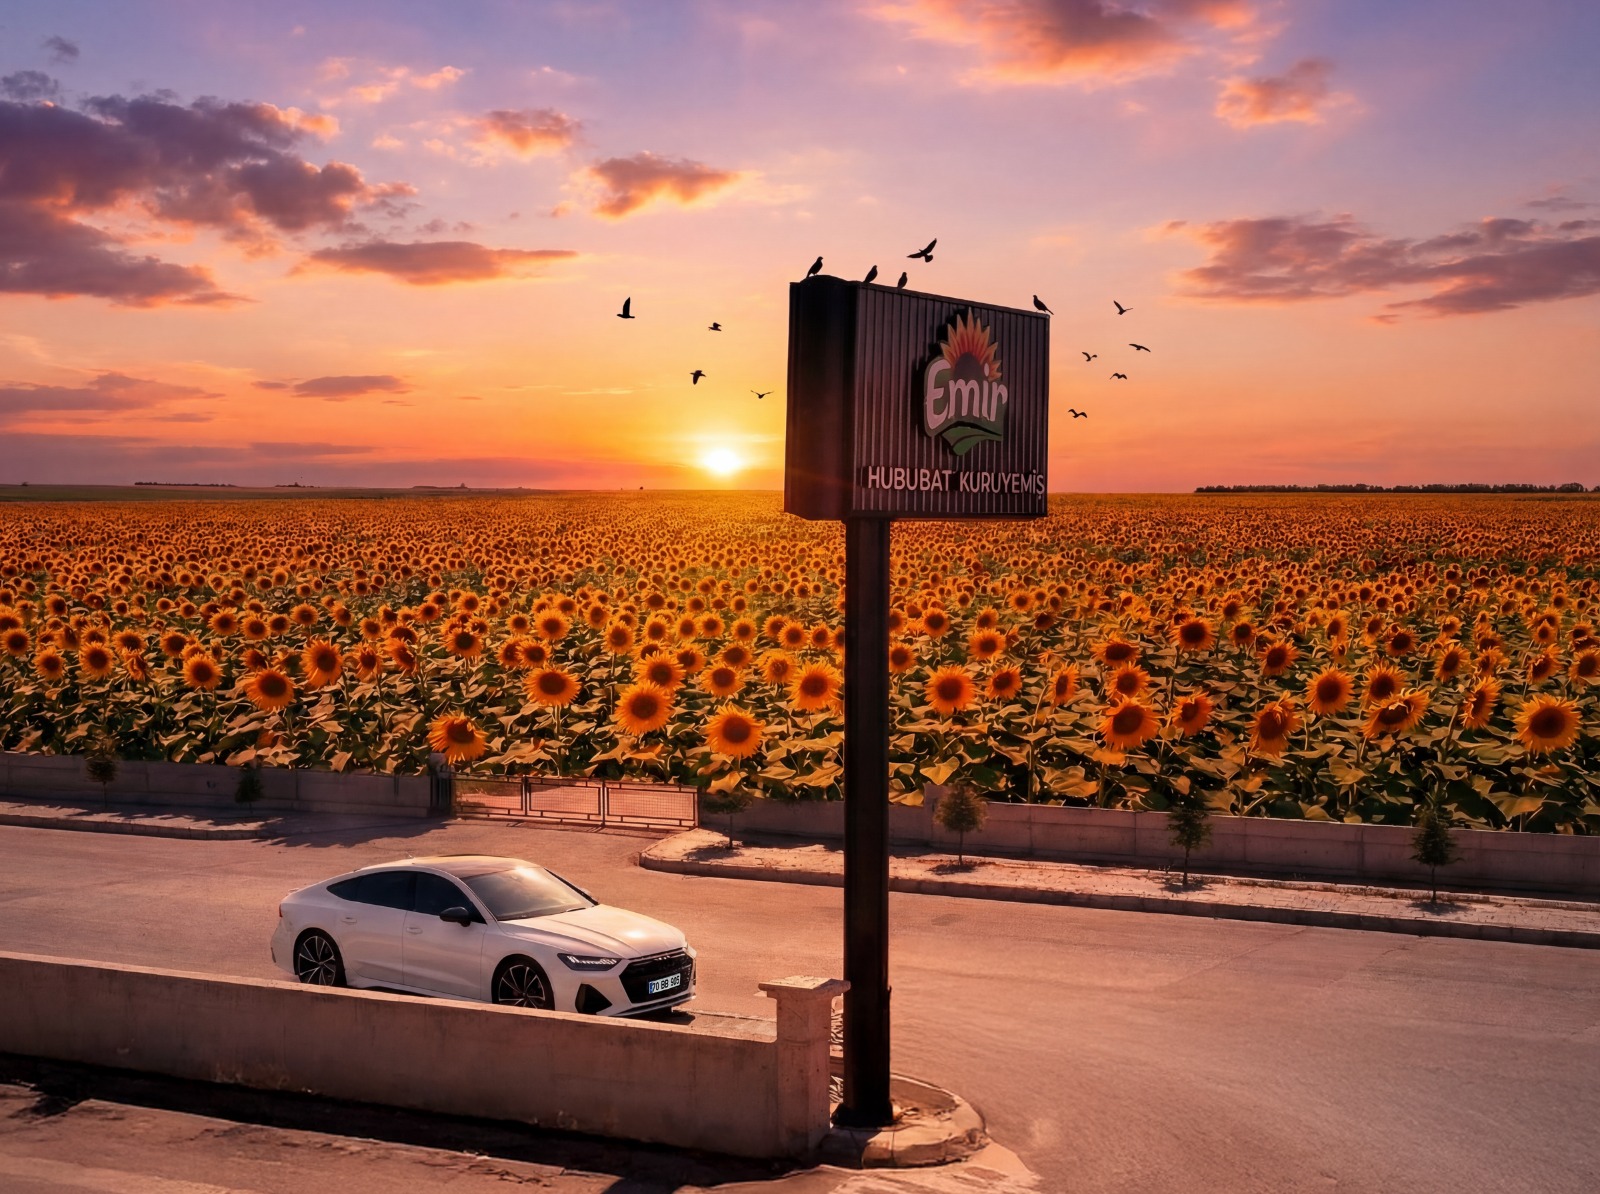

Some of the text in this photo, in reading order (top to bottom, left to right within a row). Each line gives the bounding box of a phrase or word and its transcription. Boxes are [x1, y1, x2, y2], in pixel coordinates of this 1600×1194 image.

[926, 359, 1008, 430] Emir
[868, 466, 1045, 500] HUBUBAT KURUYEMİŞ
[652, 982, 659, 992] 70
